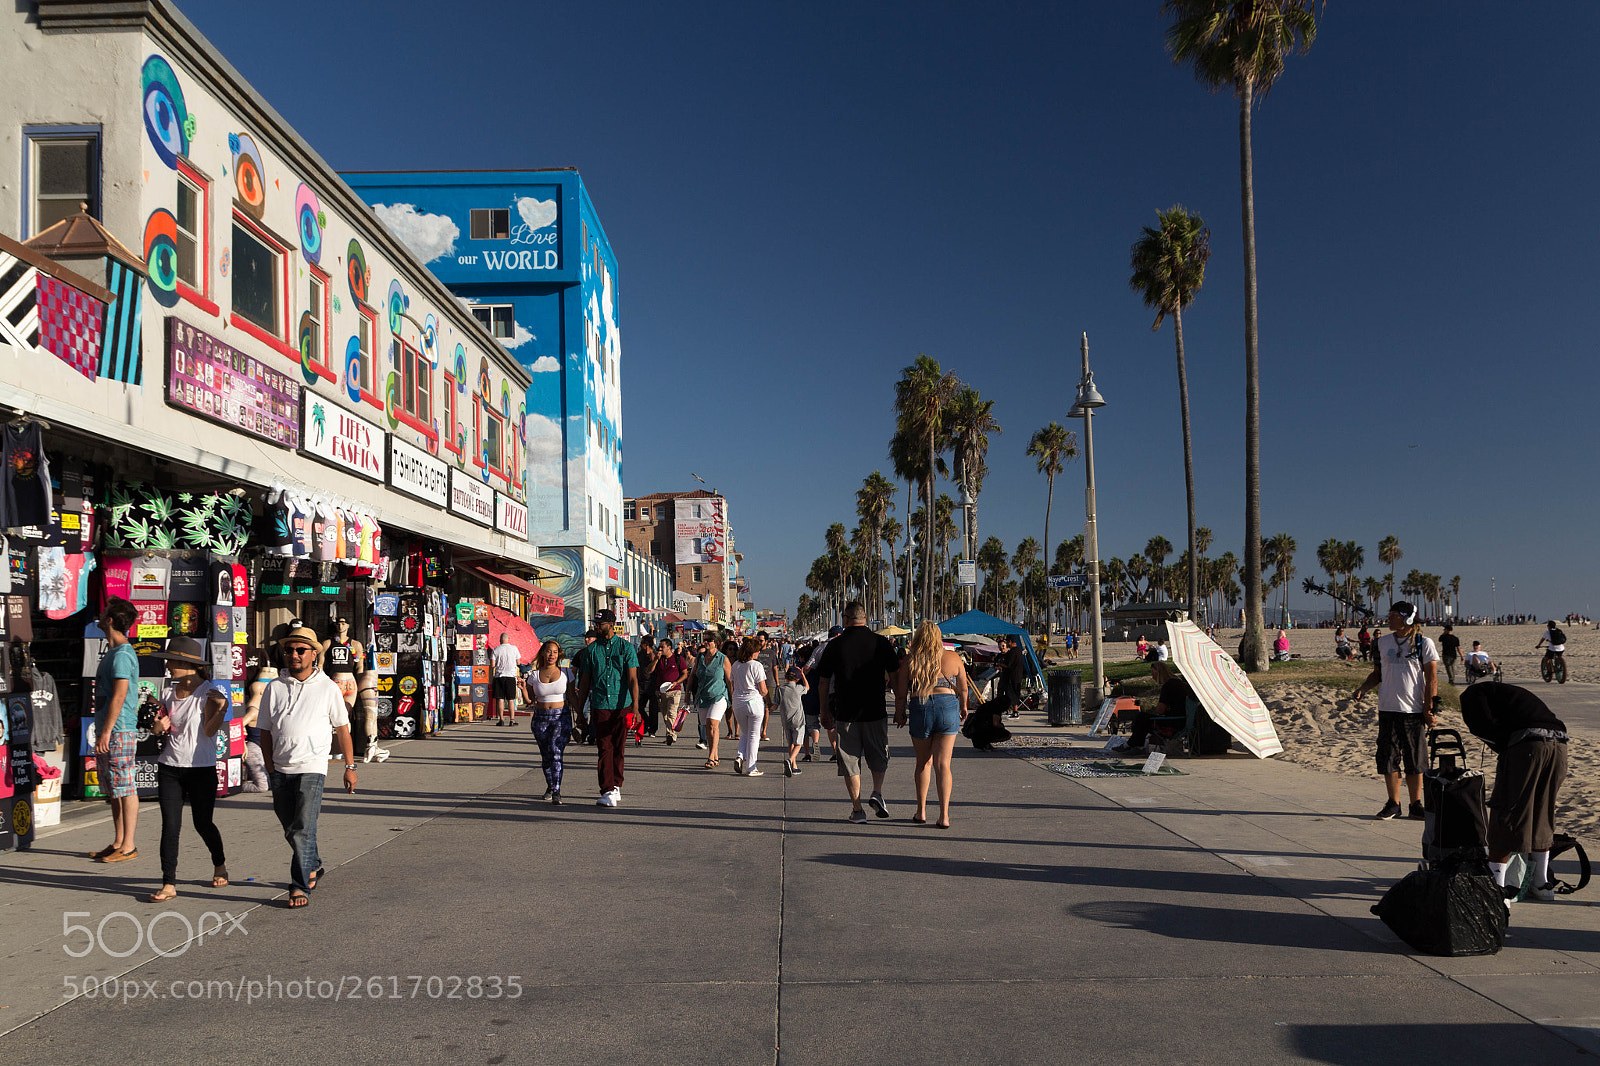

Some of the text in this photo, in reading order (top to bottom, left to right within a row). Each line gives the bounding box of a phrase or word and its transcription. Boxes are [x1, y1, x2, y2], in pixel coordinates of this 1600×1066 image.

[510, 223, 557, 245] Love
[457, 250, 558, 270] our WORLD
[340, 414, 371, 448] LIFE'S
[332, 435, 379, 474] FASHION
[430, 467, 446, 497] GIFTS
[504, 502, 527, 535] PIZZA
[263, 559, 284, 568] GAY
[321, 586, 340, 595] SHIRT
